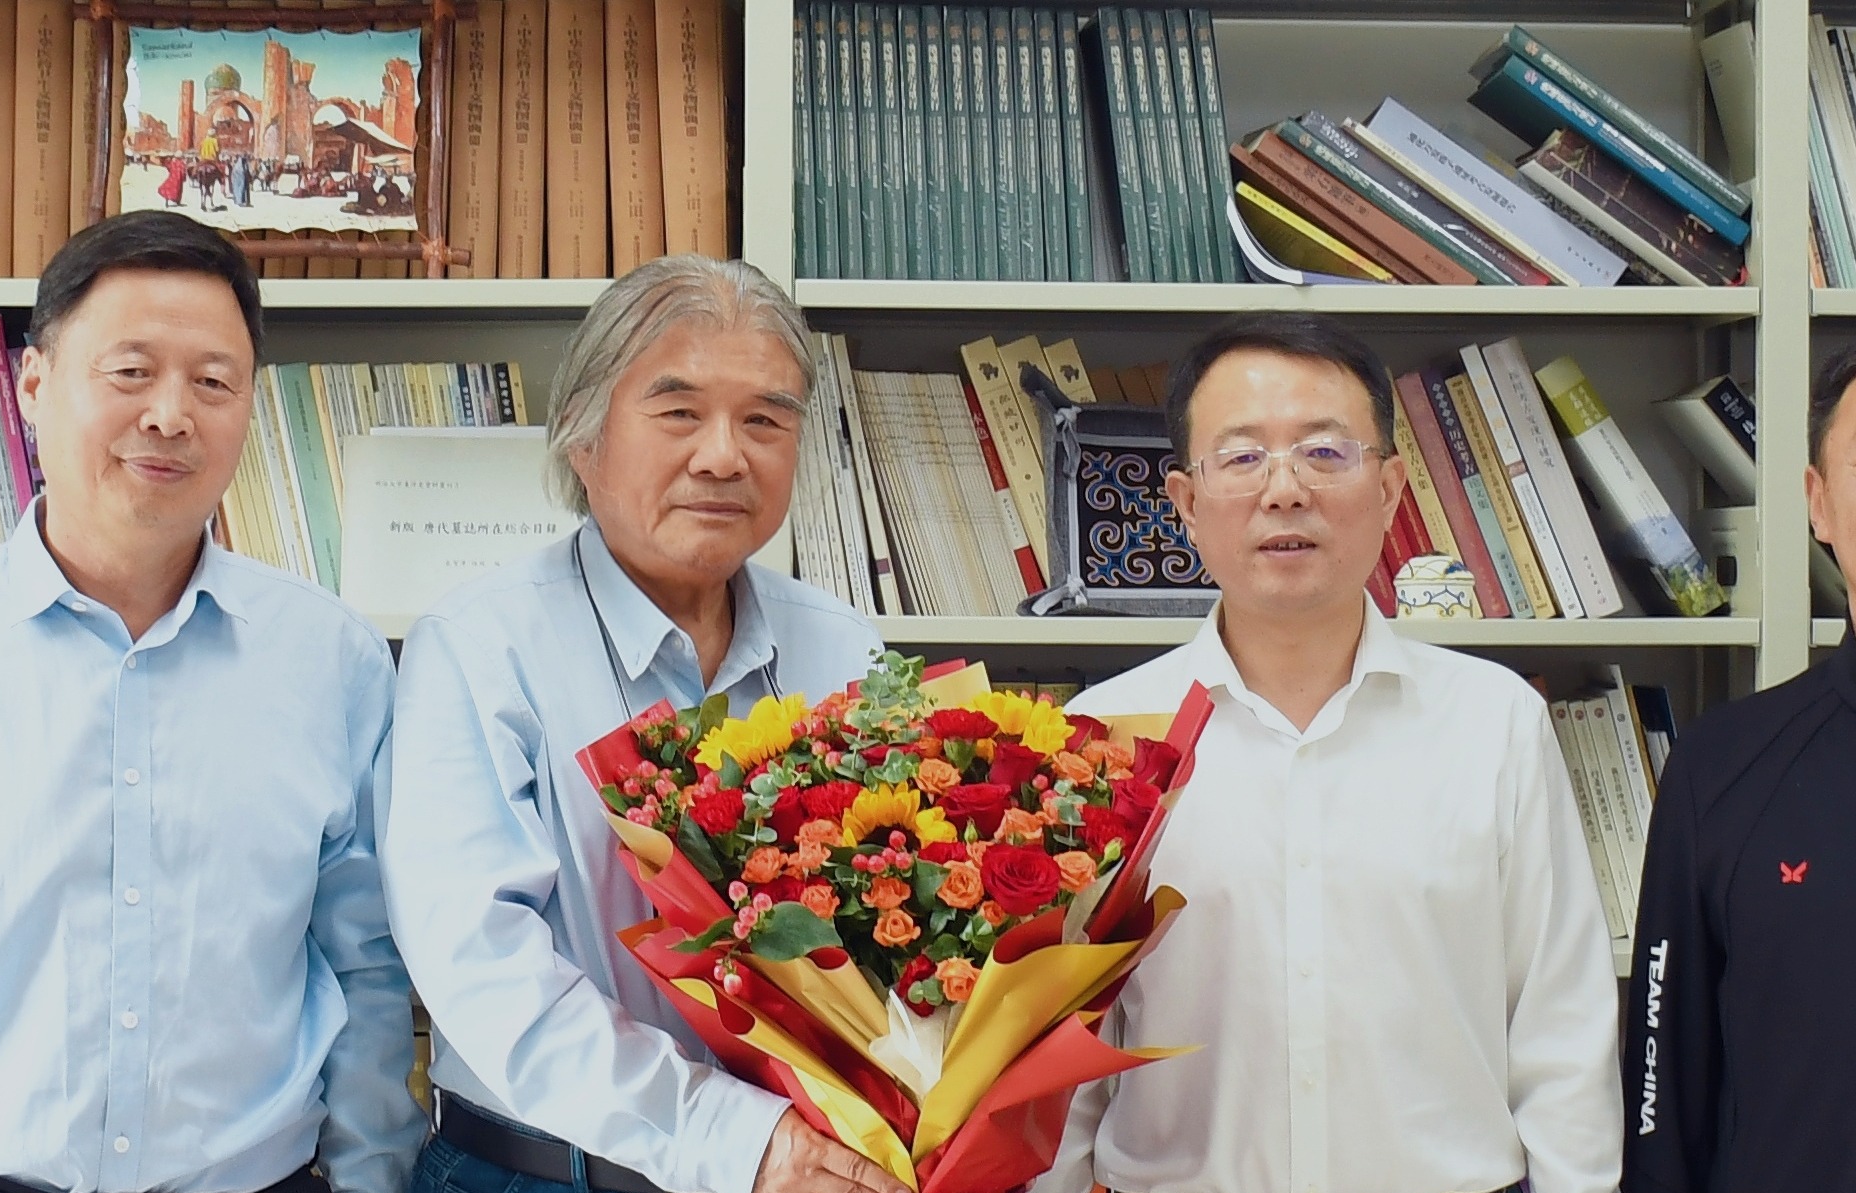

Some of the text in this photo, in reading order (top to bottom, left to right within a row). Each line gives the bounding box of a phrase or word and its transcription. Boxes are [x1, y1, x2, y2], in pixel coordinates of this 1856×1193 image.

[389, 520, 415, 535] 新版
[1638, 939, 1669, 1137] TEAM CHINA
